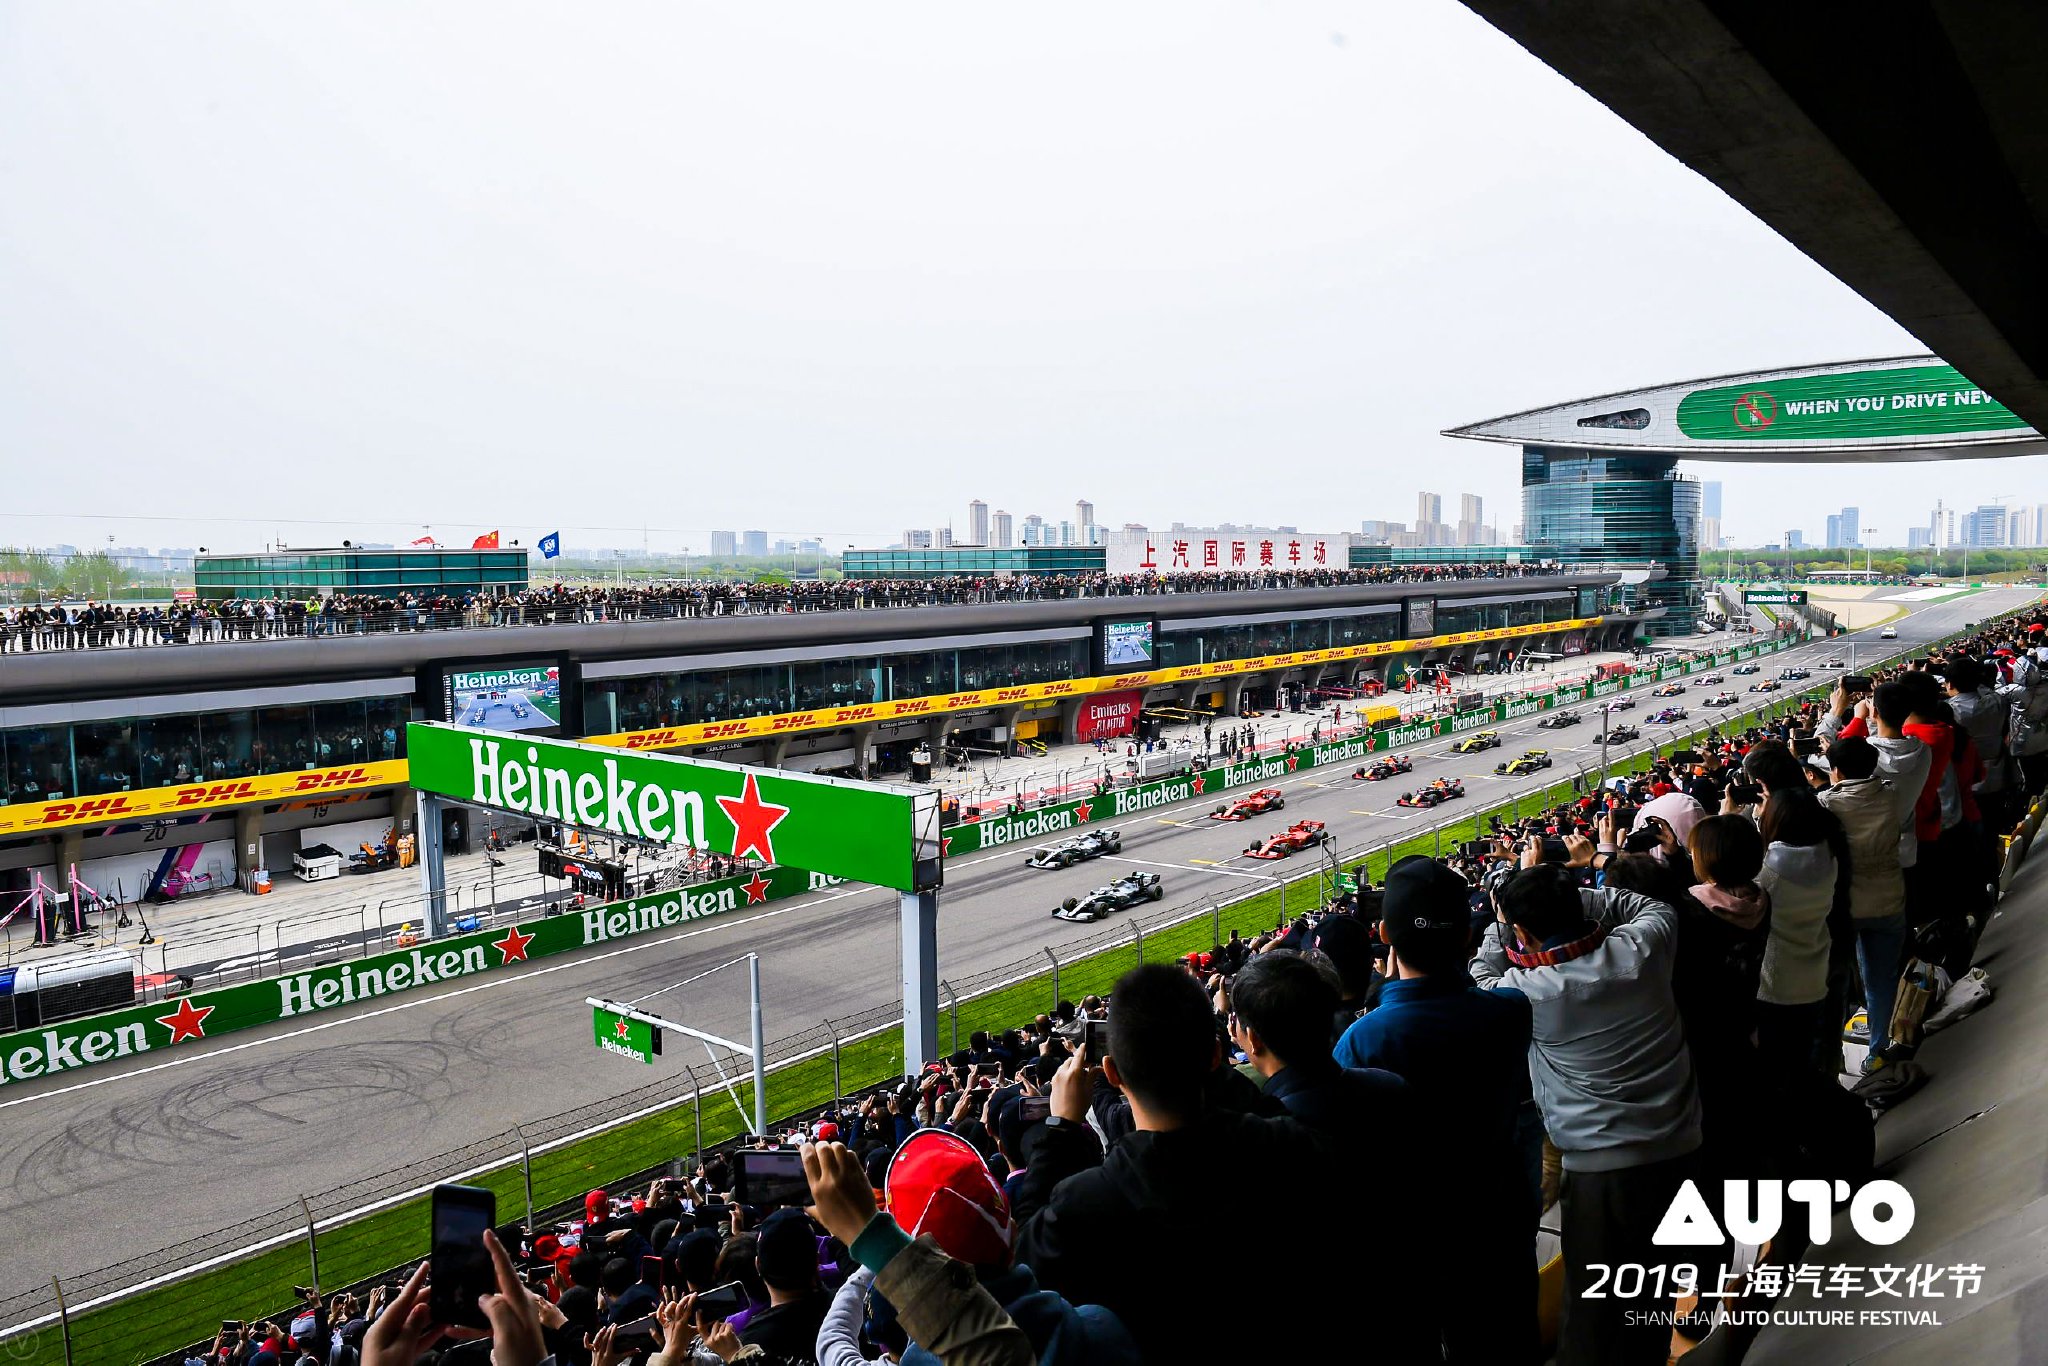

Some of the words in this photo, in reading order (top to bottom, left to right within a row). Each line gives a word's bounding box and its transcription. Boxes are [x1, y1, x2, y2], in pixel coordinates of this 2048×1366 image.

[1785, 400, 1839, 416] WHEN
[1845, 396, 1885, 412] YOU
[1891, 392, 1948, 409] DRIVE
[1140, 539, 1326, 568] 上汽国际赛车场
[1108, 624, 1145, 635] Heineken
[1328, 649, 1345, 659] DHL
[1353, 646, 1369, 655] DHL
[1376, 643, 1392, 653] DHL
[1244, 659, 1265, 669] DHL
[1274, 655, 1293, 665] DHL
[1302, 652, 1320, 662] DHL
[1180, 667, 1203, 678] DHL
[1213, 663, 1235, 673] DHL
[454, 671, 542, 689] Heineken
[1112, 674, 1150, 688] DHL
[1593, 680, 1618, 697] Heineken
[997, 688, 1029, 701] DHL
[1043, 682, 1073, 696] DHL
[894, 700, 931, 714] DHL
[947, 694, 981, 708] DHL
[1552, 690, 1580, 707] Heineken
[835, 706, 876, 722] DHL
[1090, 702, 1131, 720] Emirates
[1505, 699, 1538, 719] Heineken
[771, 714, 817, 730] DHL
[1451, 711, 1489, 732] Heineken
[702, 722, 751, 739] DHL
[1388, 725, 1431, 748] Heineken
[626, 730, 679, 749] DHL
[1312, 740, 1365, 767] Heineken
[295, 768, 370, 791] DHL
[1223, 759, 1285, 788] Heineken
[175, 782, 258, 806] DHL
[469, 737, 711, 852] Heineken
[1114, 781, 1189, 816] Heineken
[42, 797, 133, 823] DHL
[313, 805, 329, 818] 19
[143, 828, 167, 842] 20
[978, 810, 1072, 849] Heineken
[581, 885, 737, 946] Heineken
[277, 945, 489, 1018] Heineken
[0, 1022, 151, 1086] eken
[601, 1036, 646, 1063] Heineken
